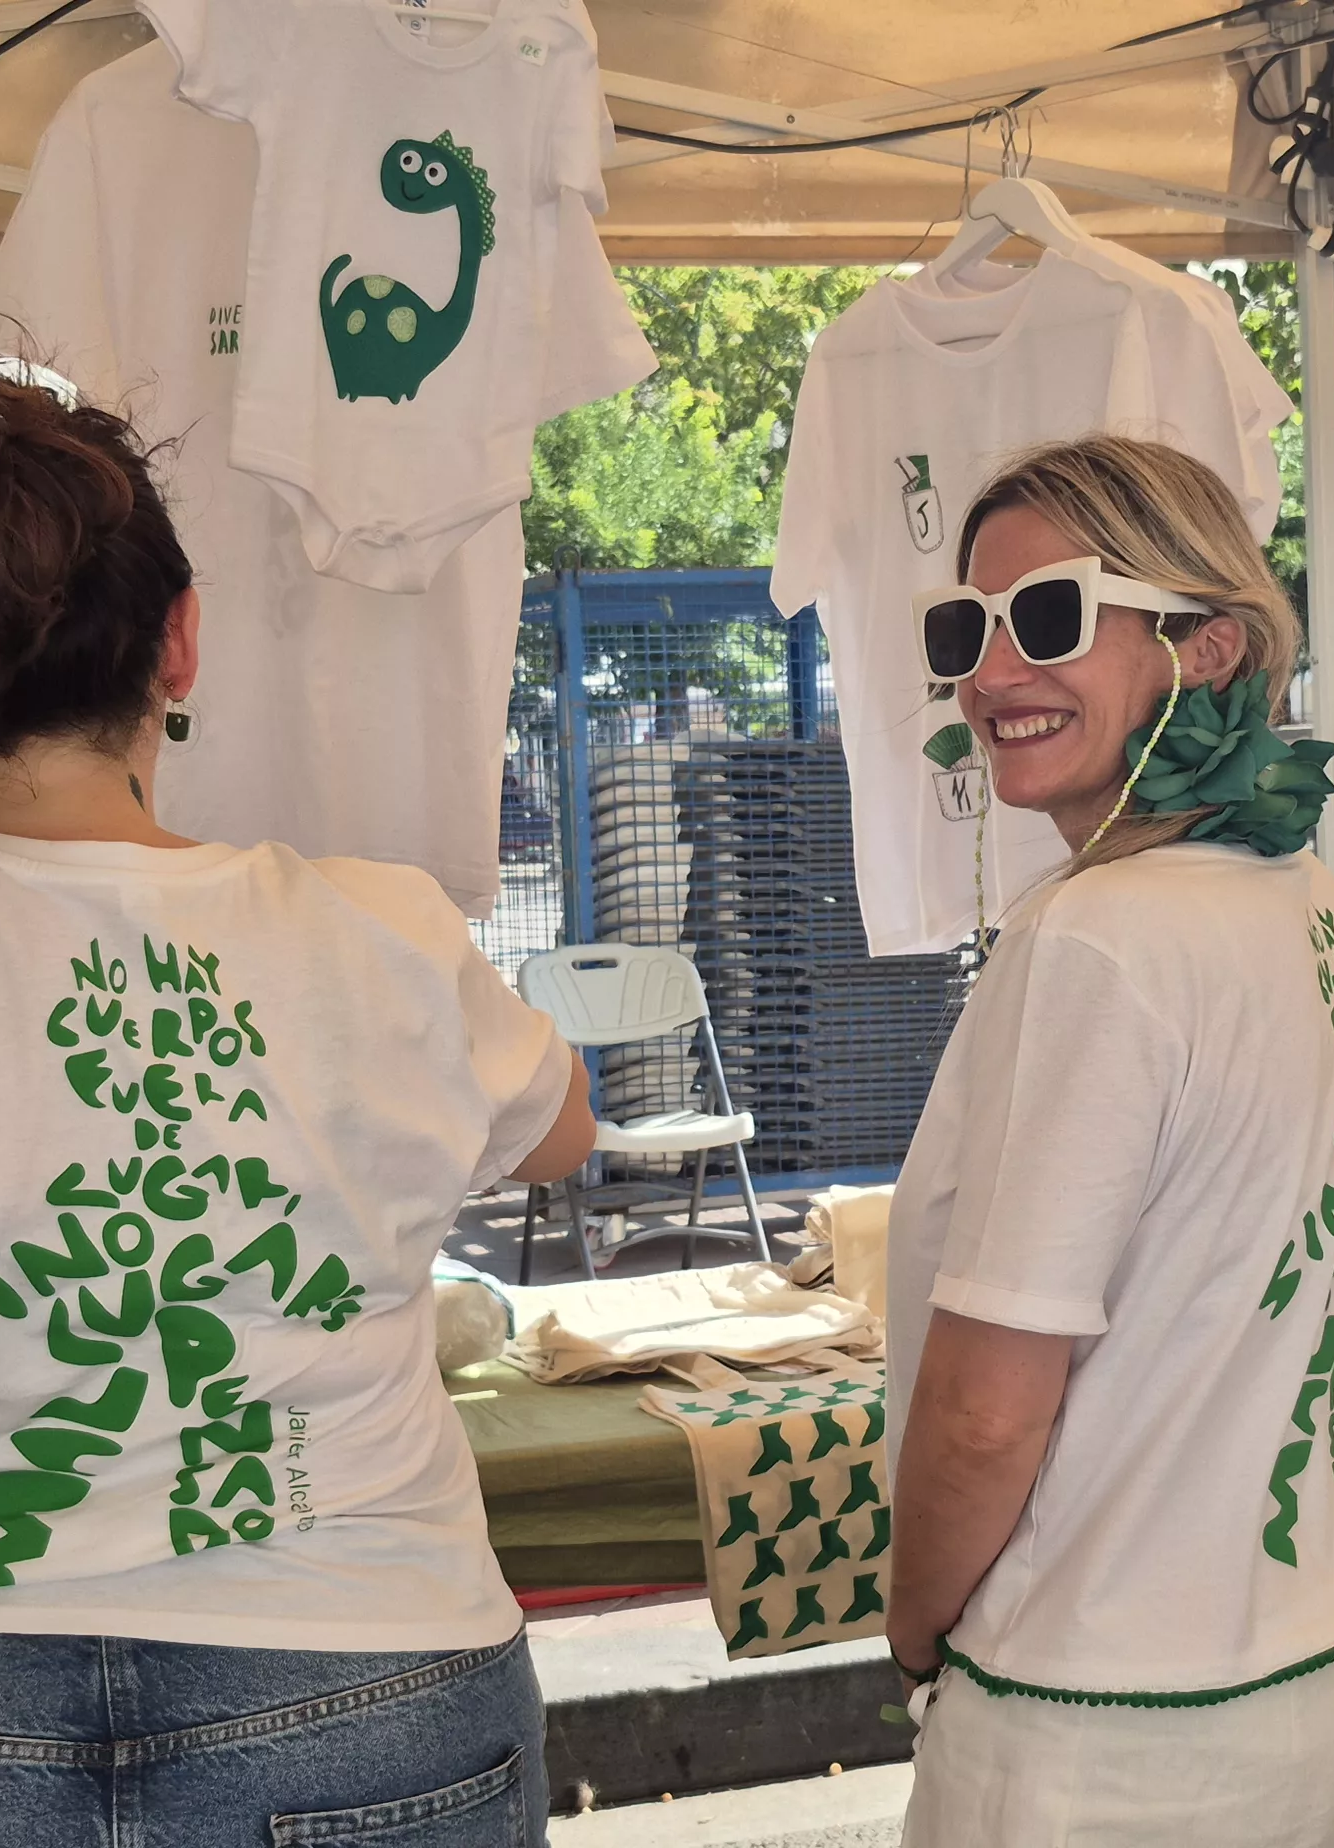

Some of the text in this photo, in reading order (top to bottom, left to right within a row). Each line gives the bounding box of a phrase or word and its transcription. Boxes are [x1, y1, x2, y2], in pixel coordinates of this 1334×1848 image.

[70, 932, 222, 996] NO HAY
[46, 993, 267, 1067] CUERPOS
[64, 1047, 268, 1122] FUERA
[134, 1117, 182, 1151] DE
